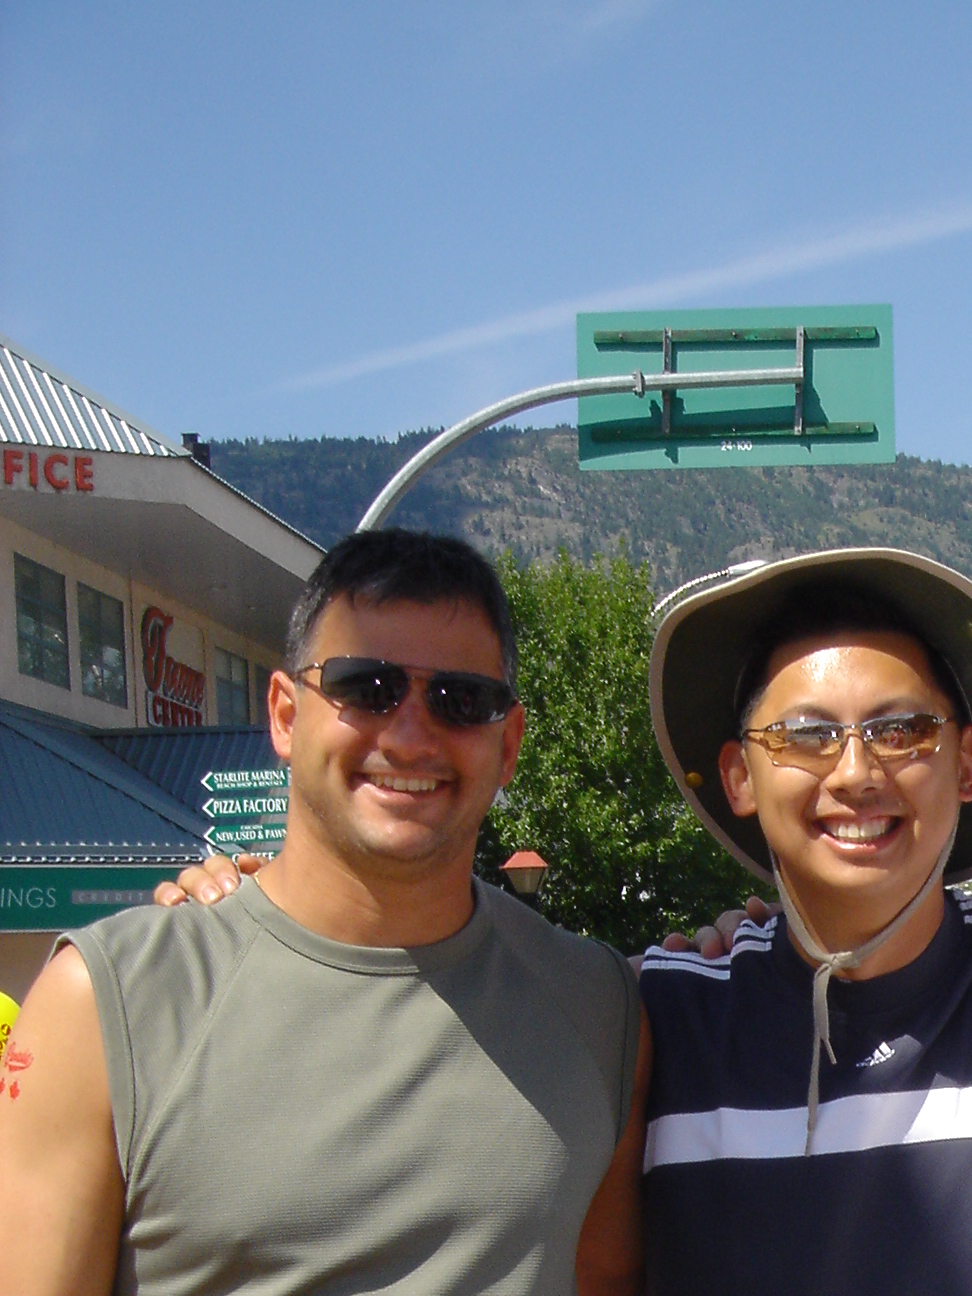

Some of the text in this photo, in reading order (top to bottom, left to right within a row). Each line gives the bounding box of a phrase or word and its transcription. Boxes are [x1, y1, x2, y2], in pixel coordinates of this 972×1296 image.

[3, 449, 94, 492] FICE
[214, 771, 286, 782] STARLITE MARINA
[213, 798, 288, 814] PIZZA FACTORY
